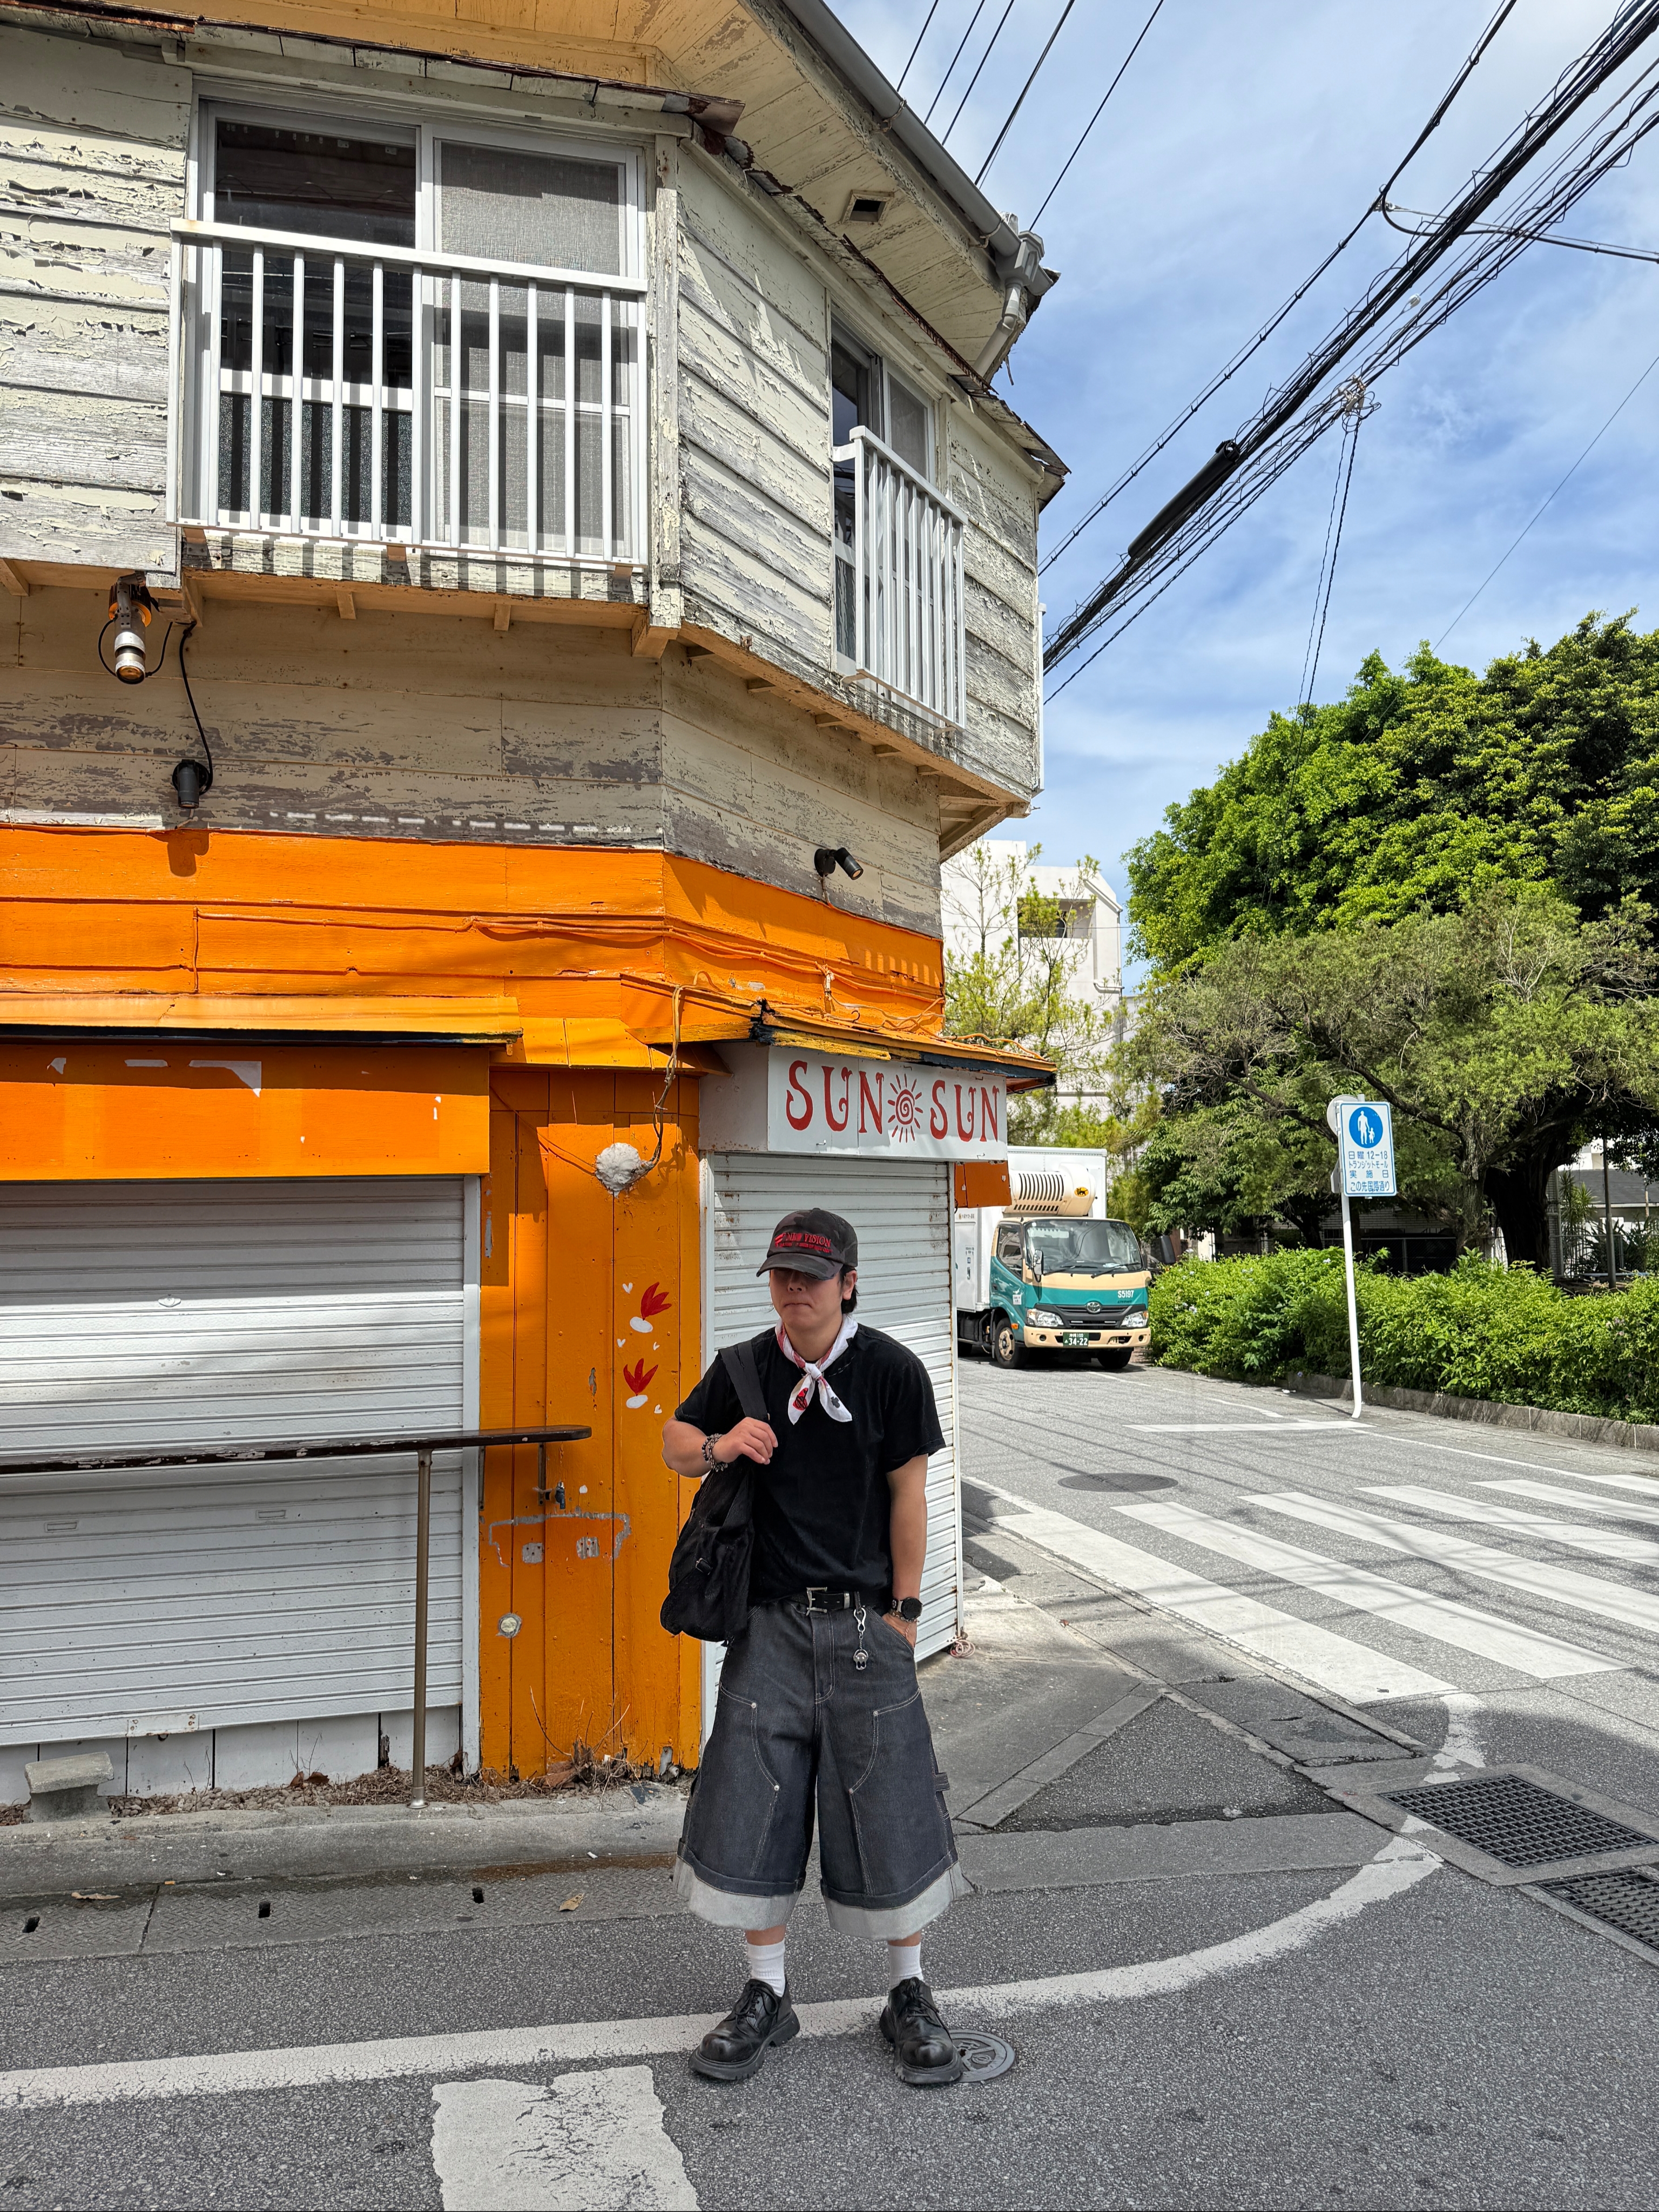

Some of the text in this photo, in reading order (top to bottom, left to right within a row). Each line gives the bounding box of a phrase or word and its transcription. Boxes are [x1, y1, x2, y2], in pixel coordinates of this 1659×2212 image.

[786, 1060, 1000, 1142] SUN SUN
[1348, 1151, 1387, 1159] 日曜 12-18
[1349, 1161, 1388, 1169] トランジットモール
[1351, 1181, 1390, 1191] この先国際通り
[805, 1233, 831, 1247] VISION
[1117, 1290, 1134, 1298] S5197
